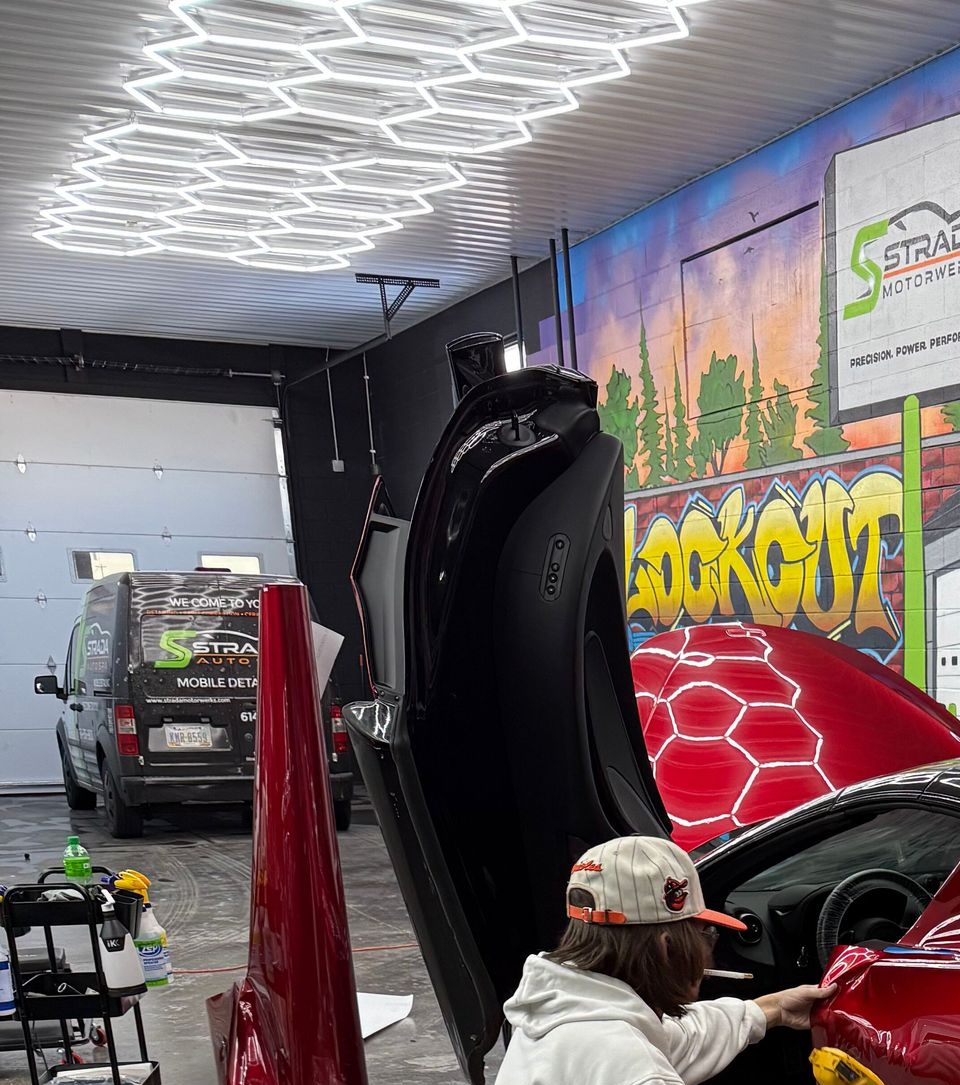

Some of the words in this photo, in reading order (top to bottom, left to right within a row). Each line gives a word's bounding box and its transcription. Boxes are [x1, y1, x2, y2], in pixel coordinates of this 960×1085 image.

[850, 349, 894, 368] PRECISION.
[169, 597, 189, 607] WE
[191, 597, 226, 608] COME
[228, 598, 244, 608] TO
[246, 599, 260, 608] YO
[192, 641, 259, 653] STRA
[177, 677, 226, 688] MOBILE
[240, 711, 257, 722] 614
